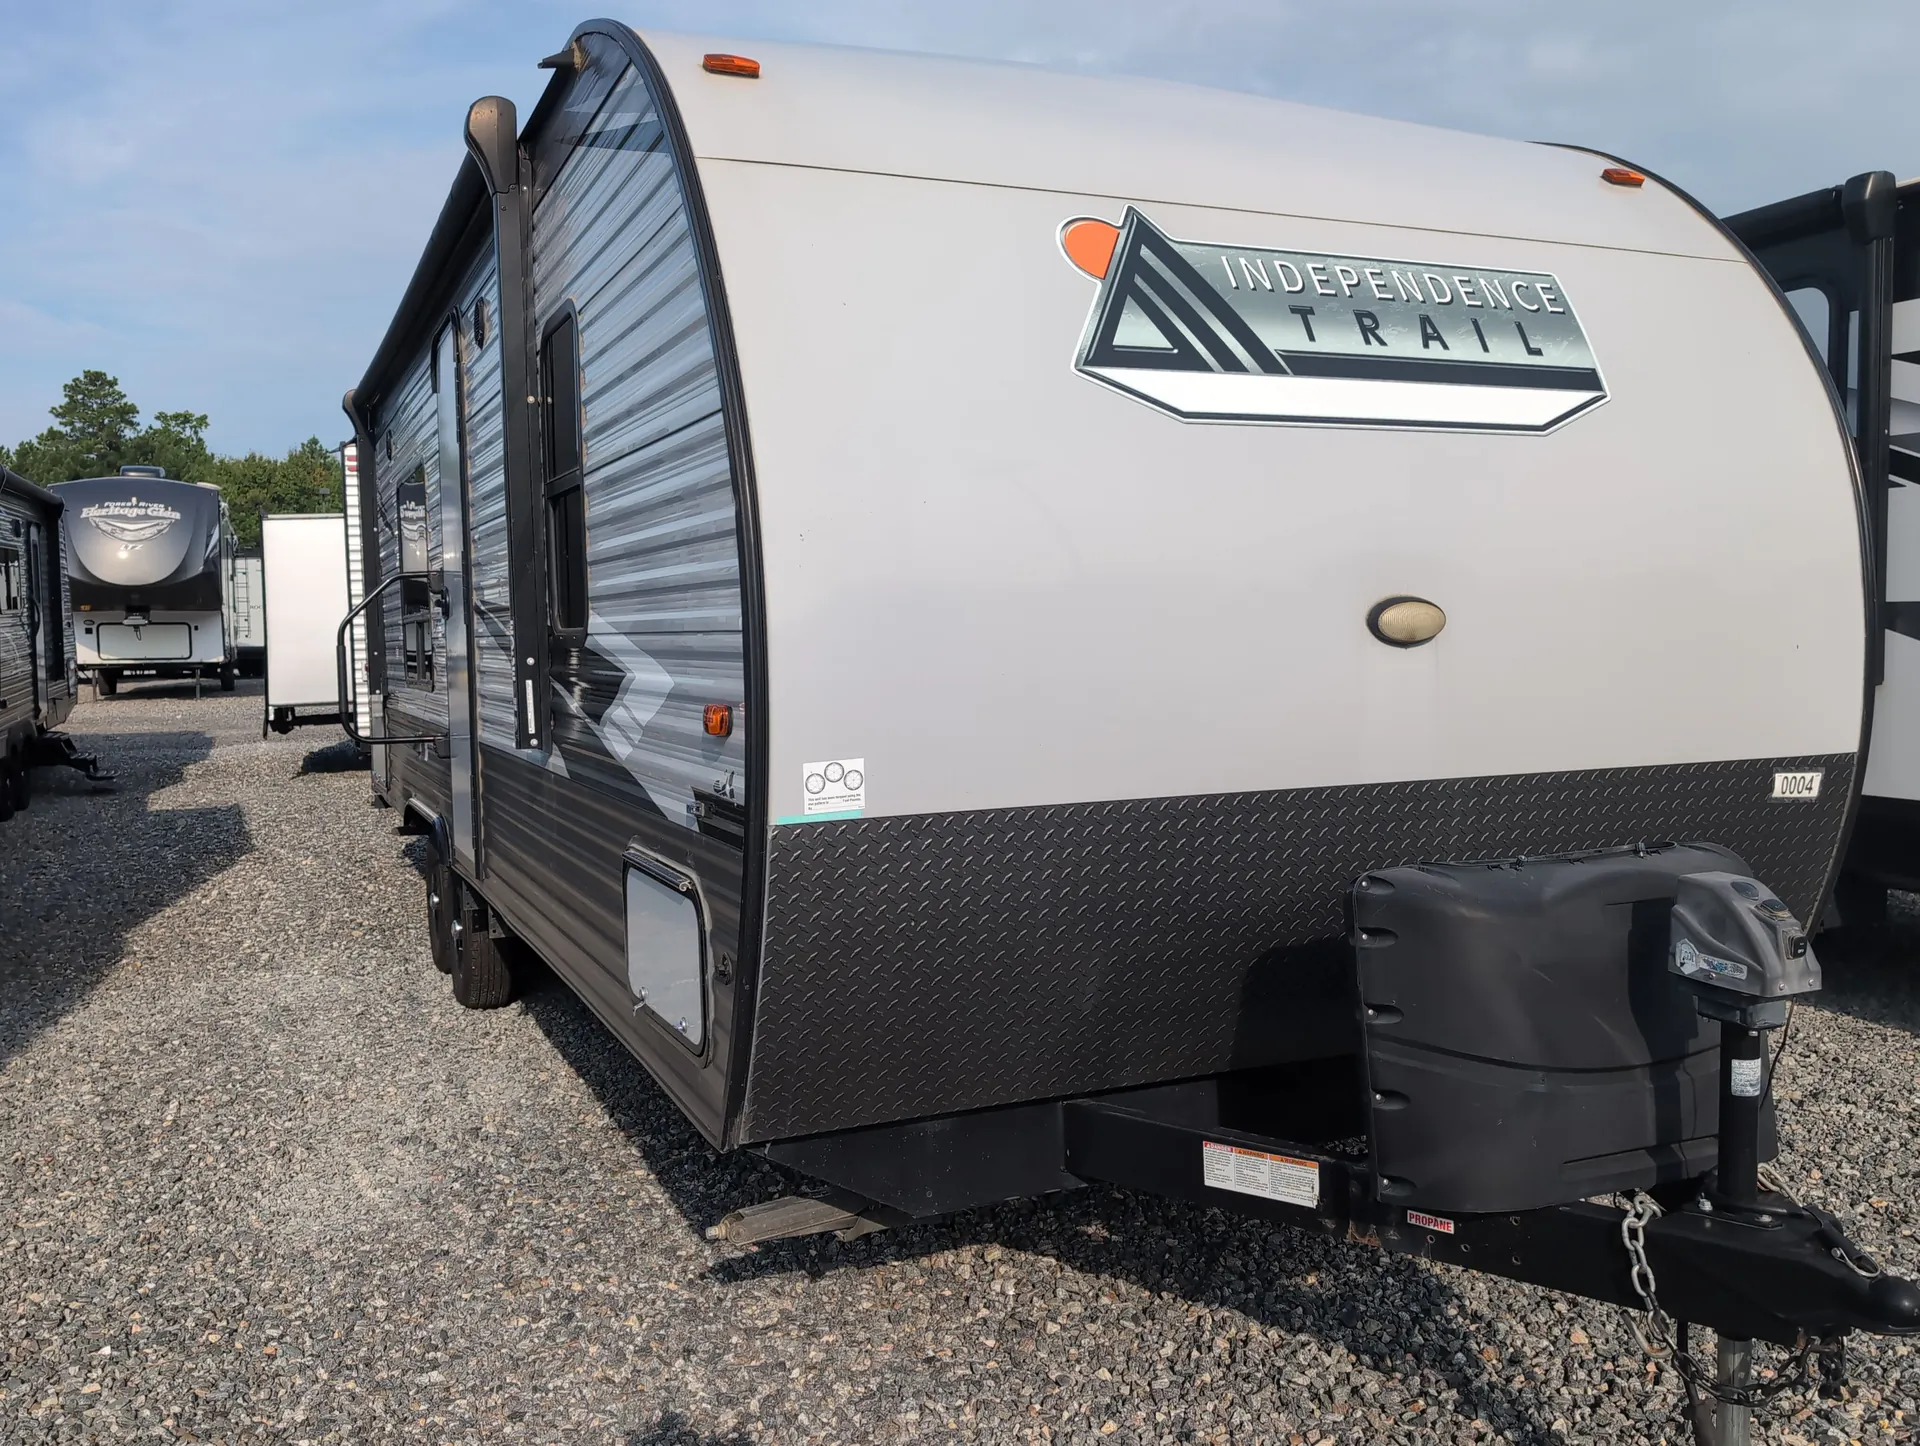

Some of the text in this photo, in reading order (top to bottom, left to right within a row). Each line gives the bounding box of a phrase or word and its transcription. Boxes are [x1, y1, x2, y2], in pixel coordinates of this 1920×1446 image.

[1220, 255, 1567, 315] INDEPENDENCE
[1289, 305, 1544, 357] TRAIL
[80, 504, 181, 519] Heritage Glen
[138, 501, 165, 509] RIVER
[120, 543, 144, 551] LTZ
[1781, 775, 1815, 795] 0004
[1211, 1142, 1232, 1152] DANGER
[1242, 1149, 1265, 1159] WARNING
[1409, 1212, 1452, 1232] PROPANE
